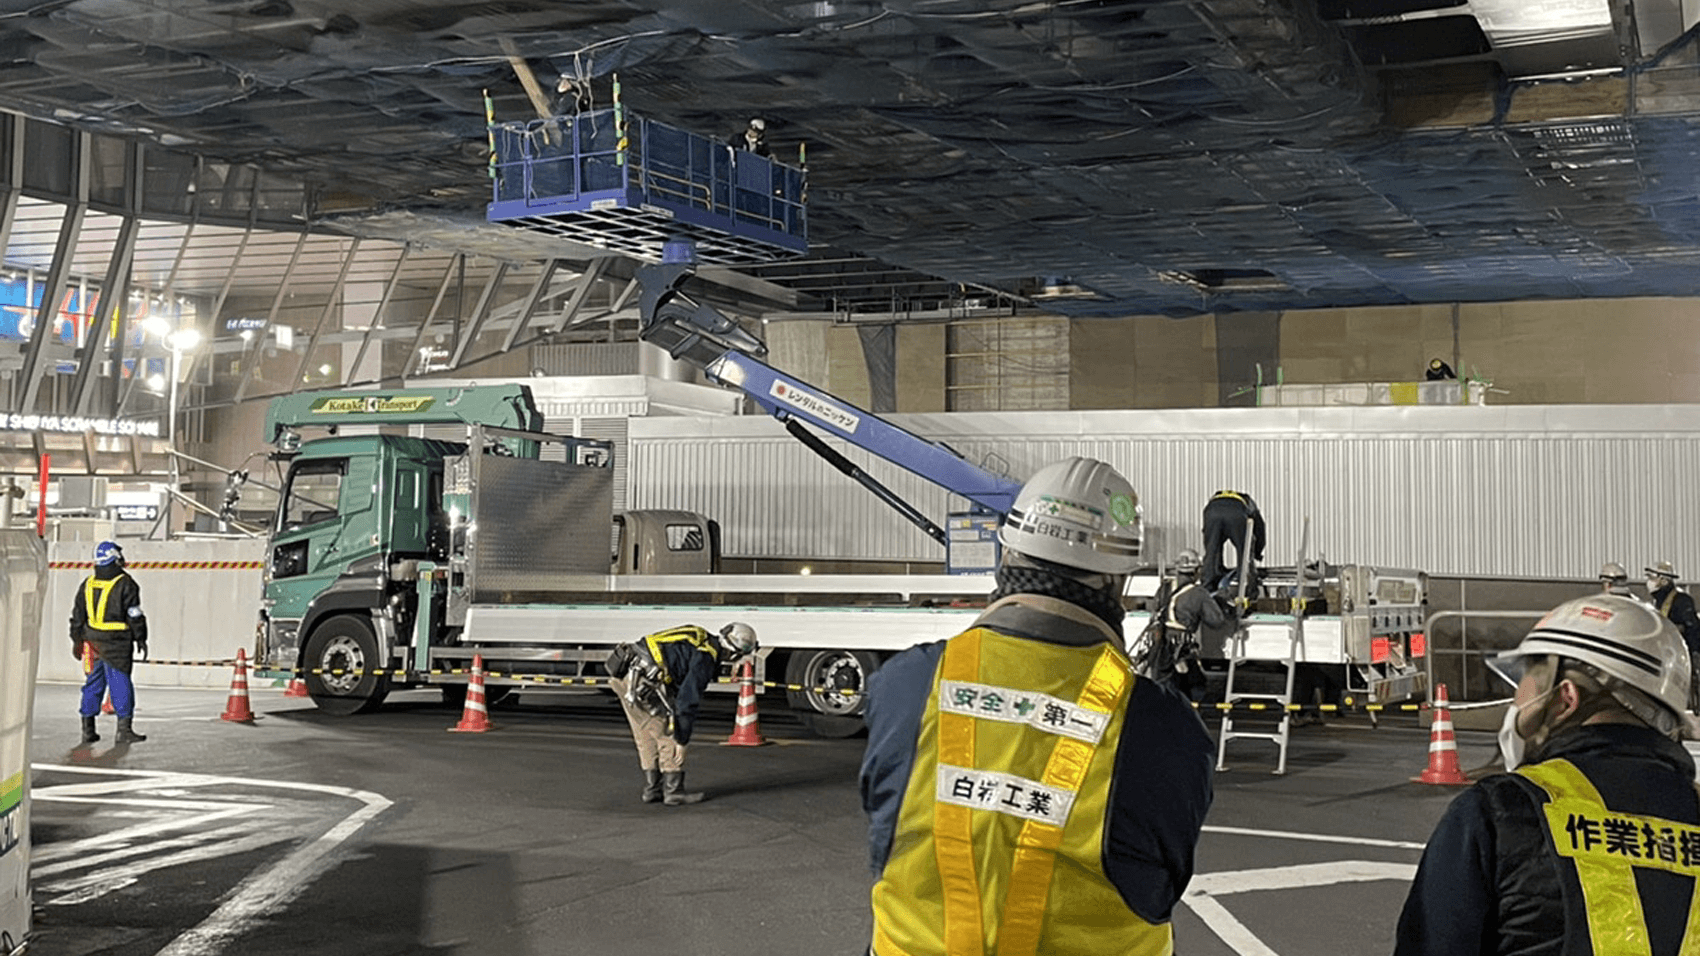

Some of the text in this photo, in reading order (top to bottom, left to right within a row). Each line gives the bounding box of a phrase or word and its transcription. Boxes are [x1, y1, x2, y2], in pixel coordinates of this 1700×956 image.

[328, 400, 363, 411] Kotake
[788, 390, 855, 427] レンタルのニッケン
